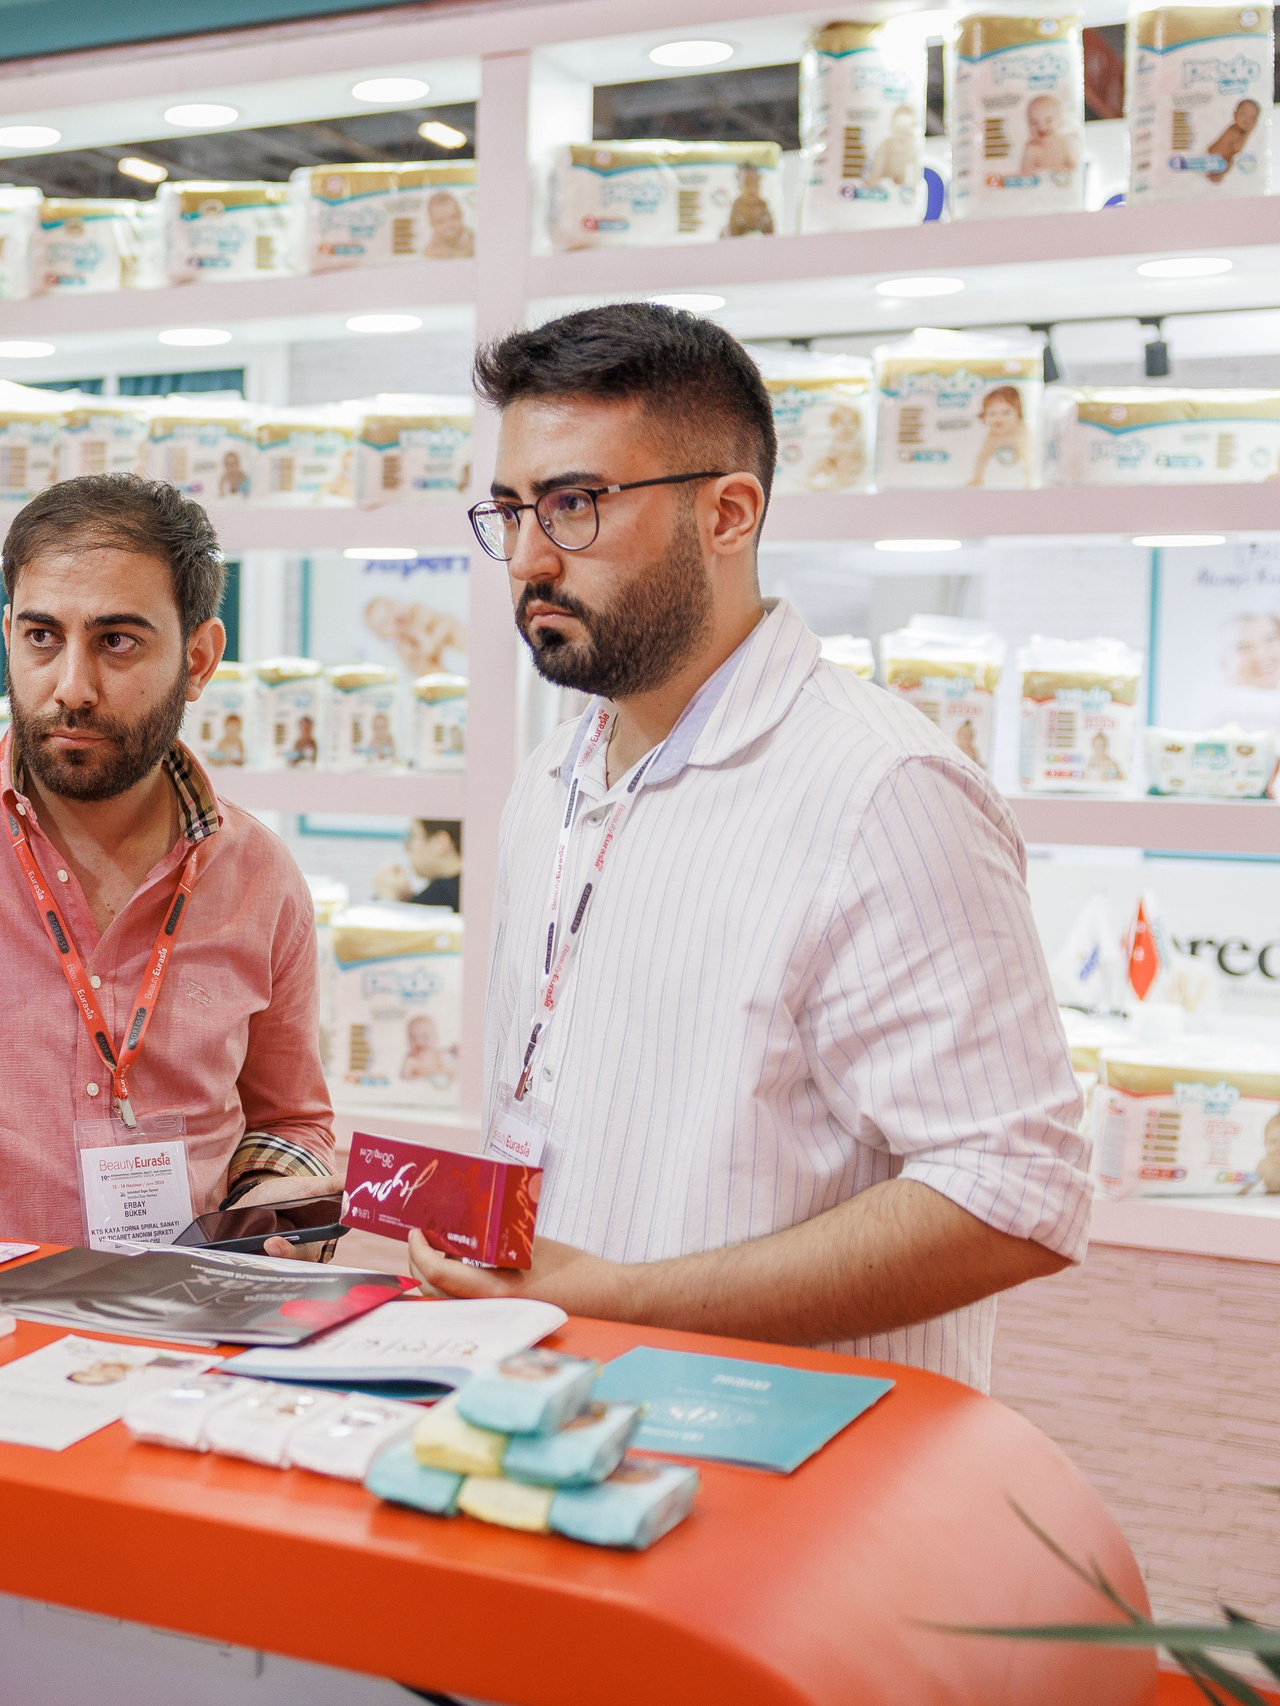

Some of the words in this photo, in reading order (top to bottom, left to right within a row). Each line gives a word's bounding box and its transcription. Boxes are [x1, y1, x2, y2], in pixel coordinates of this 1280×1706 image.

[578, 712, 610, 768] BeautyEurasia
[572, 886, 591, 931] MORFOSE
[48, 914, 69, 951] MORFOSE
[144, 947, 168, 999] BeautyEurasia
[66, 963, 94, 1021] BeautyEurasia
[129, 1009, 145, 1046] MORFOSE
[99, 1153, 171, 1171] BeautyEurasia
[123, 1201, 146, 1209] ERBAY
[124, 1209, 147, 1218] BÜKEN
[91, 1228, 104, 1236] KTS
[104, 1226, 121, 1234] KAYA
[121, 1224, 140, 1232] TORNA
